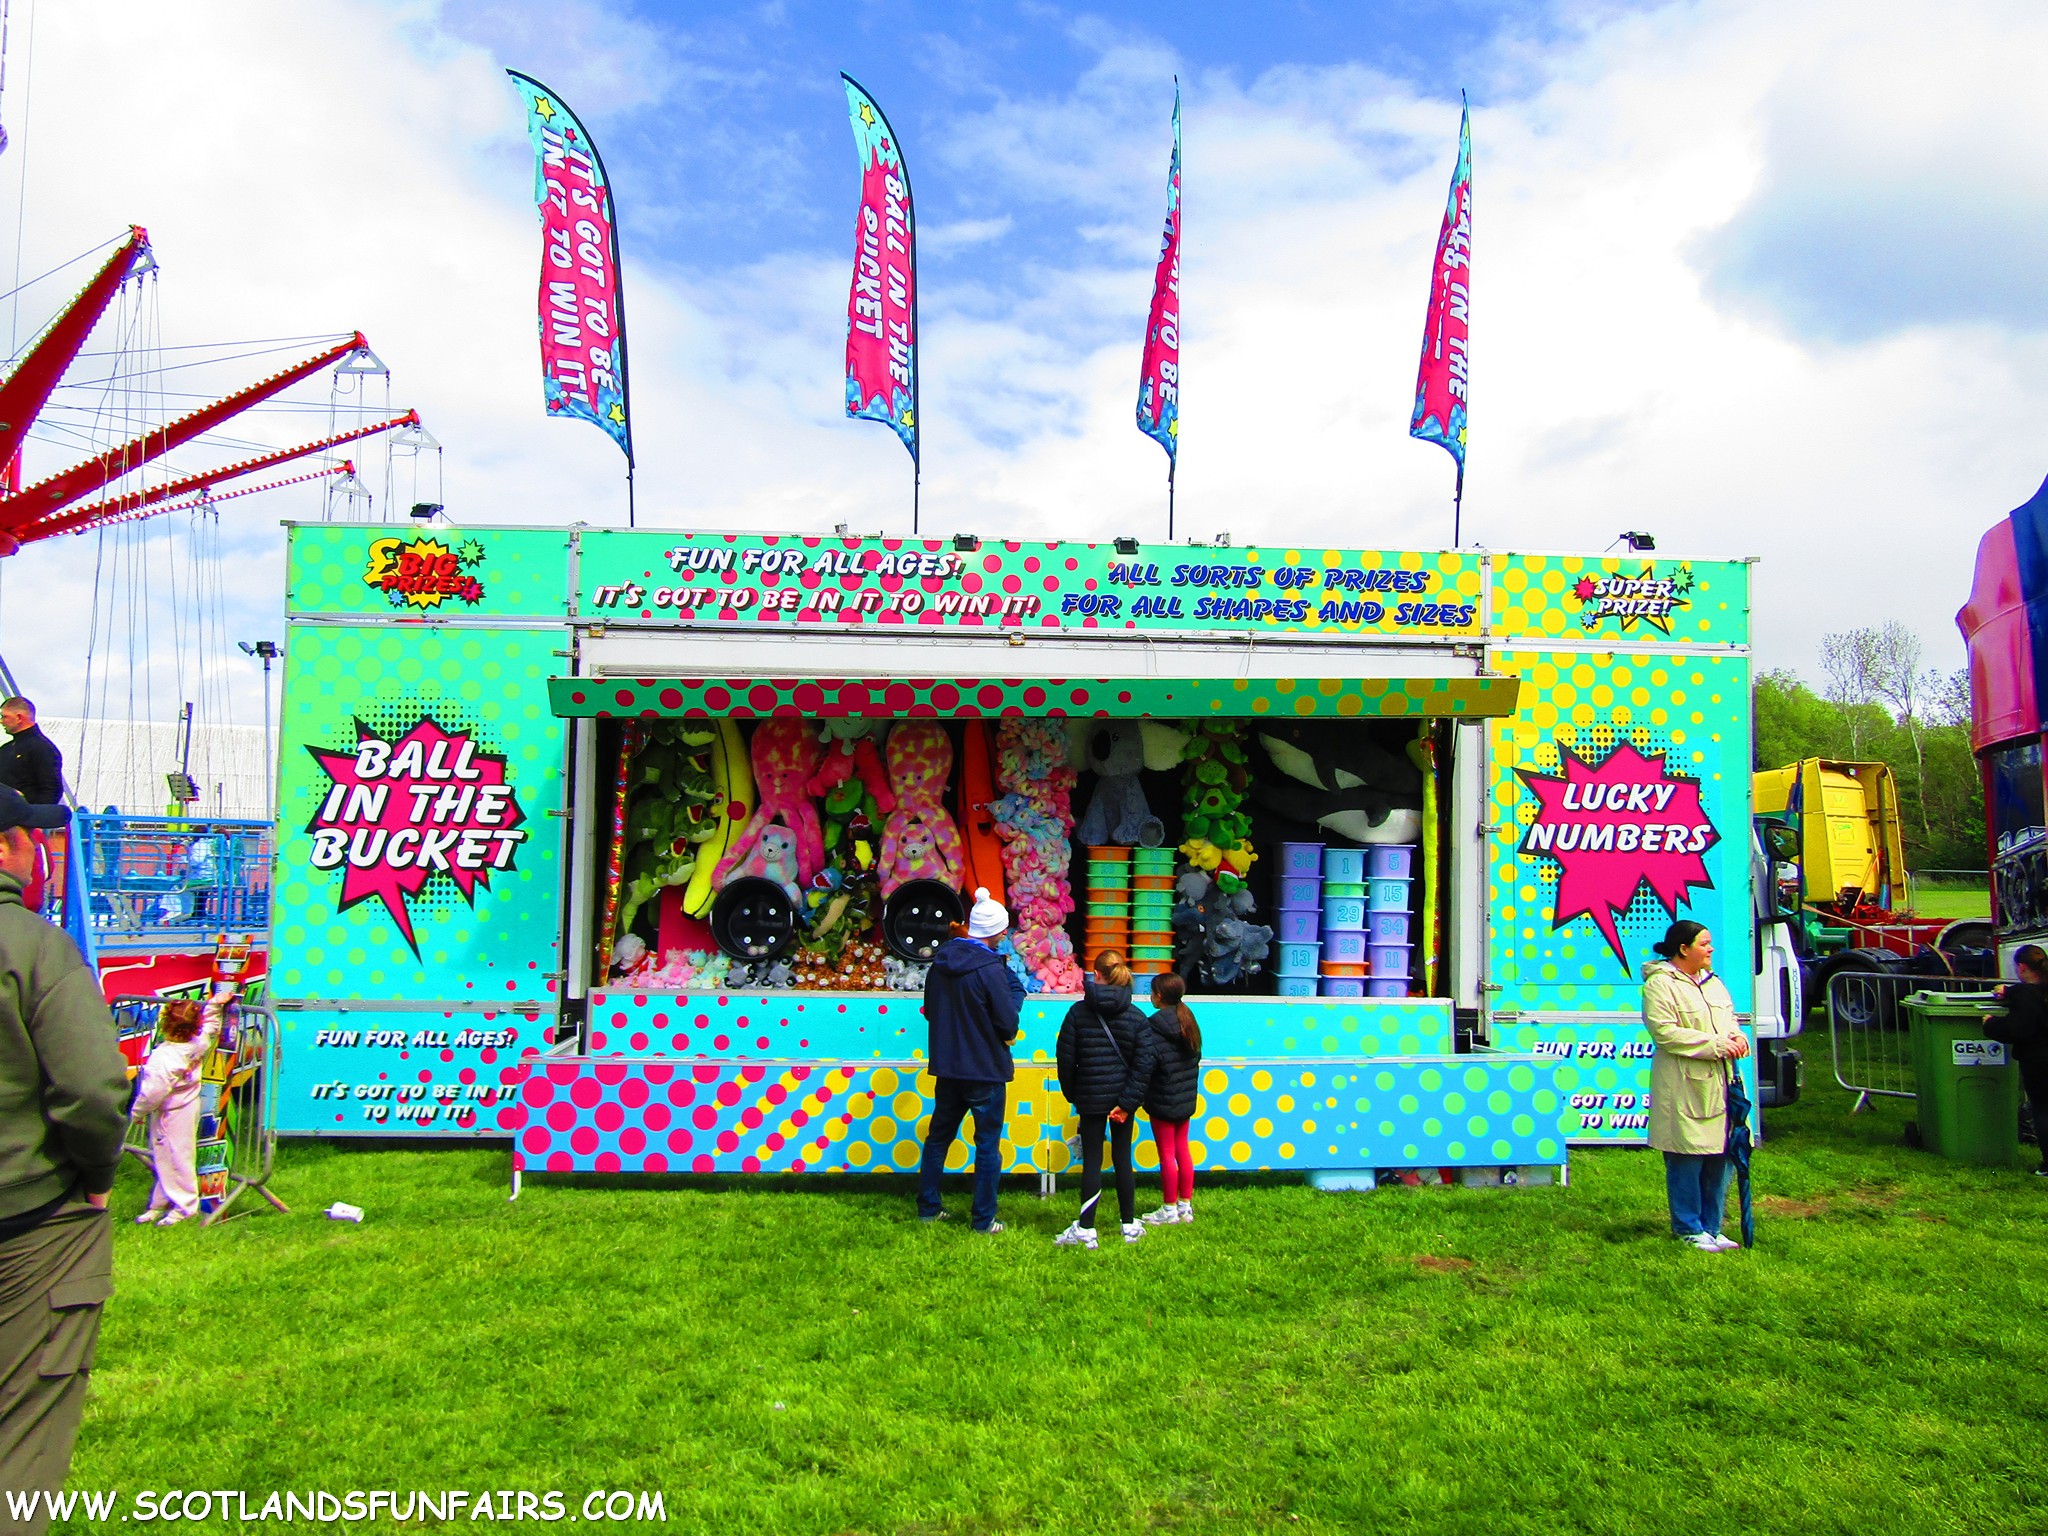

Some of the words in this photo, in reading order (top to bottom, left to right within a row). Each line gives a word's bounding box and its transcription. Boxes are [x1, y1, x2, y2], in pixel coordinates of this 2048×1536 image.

[541, 127, 566, 170] IN
[569, 149, 597, 212] IT'S
[884, 173, 909, 257] BALL
[549, 228, 572, 268] TO
[575, 219, 604, 288] GOT
[856, 205, 883, 339] BUCKET
[887, 265, 908, 310] IN
[549, 281, 582, 347] WIN
[583, 297, 610, 337] TO
[1450, 283, 1469, 325] IN
[1161, 310, 1179, 349] TO
[589, 348, 614, 391] BE
[888, 321, 909, 388] THE
[1449, 337, 1468, 403] THE
[555, 358, 589, 403] IT!
[1160, 360, 1178, 406] BE
[398, 553, 458, 577] BIG
[669, 547, 733, 573] FUN
[743, 549, 804, 575] FOR
[813, 551, 865, 575] ALL
[875, 553, 966, 579] AGES!
[1108, 564, 1159, 586] ALL
[1171, 565, 1263, 588] SORTS
[1273, 566, 1317, 588] OF
[1325, 568, 1430, 592] PRIZES
[381, 575, 475, 594] PRIZES!
[592, 581, 643, 606] IT'S
[653, 586, 710, 608] GOT
[718, 589, 750, 609] TO
[762, 590, 800, 611] BE
[808, 591, 843, 611] IN
[851, 592, 876, 613] IT
[891, 593, 923, 613] TO
[933, 594, 991, 615] WIN
[1001, 596, 1037, 617] IT!
[1594, 578, 1674, 598] SUPER
[1061, 594, 1122, 618] FOR
[1131, 596, 1181, 617] ALL
[1193, 598, 1311, 620] SHAPES
[1318, 601, 1386, 623] AND
[1394, 602, 1476, 626] SIZES
[1597, 598, 1672, 617] PRIZE!
[354, 739, 481, 779] BALL
[321, 783, 390, 823] IN
[408, 784, 512, 824] THE
[1562, 782, 1676, 813] LUCKY
[310, 827, 526, 871] BUCKET
[1525, 823, 1711, 854] NUMBERS
[1343, 858, 1350, 874] 1
[1389, 854, 1399, 870] 5
[1384, 886, 1402, 902] 15
[1297, 918, 1306, 935] 7
[1337, 906, 1359, 922] 29
[1381, 919, 1403, 936] 34
[1292, 950, 1310, 967] 13
[1340, 939, 1359, 954] 23
[1385, 952, 1399, 968] 11
[316, 1030, 358, 1046] FUN
[364, 1030, 406, 1048] FOR
[412, 1031, 446, 1046] ALL
[454, 1031, 514, 1047] AGES!
[1533, 1041, 1570, 1056] FUN
[1577, 1042, 1614, 1058] FOR
[1954, 1043, 1985, 1053] GEA
[311, 1080, 347, 1098] IT'S
[354, 1084, 393, 1099] GOT
[400, 1084, 426, 1099] TO
[432, 1084, 459, 1098] BE
[466, 1084, 489, 1099] IN
[496, 1084, 516, 1099] IT
[1569, 1093, 1606, 1107] GOT
[1612, 1094, 1635, 1107] TO
[363, 1105, 387, 1119] TO
[396, 1105, 436, 1119] WIN
[444, 1105, 473, 1119] IT!
[1579, 1113, 1601, 1127] TO
[1609, 1114, 1648, 1127] WIN
